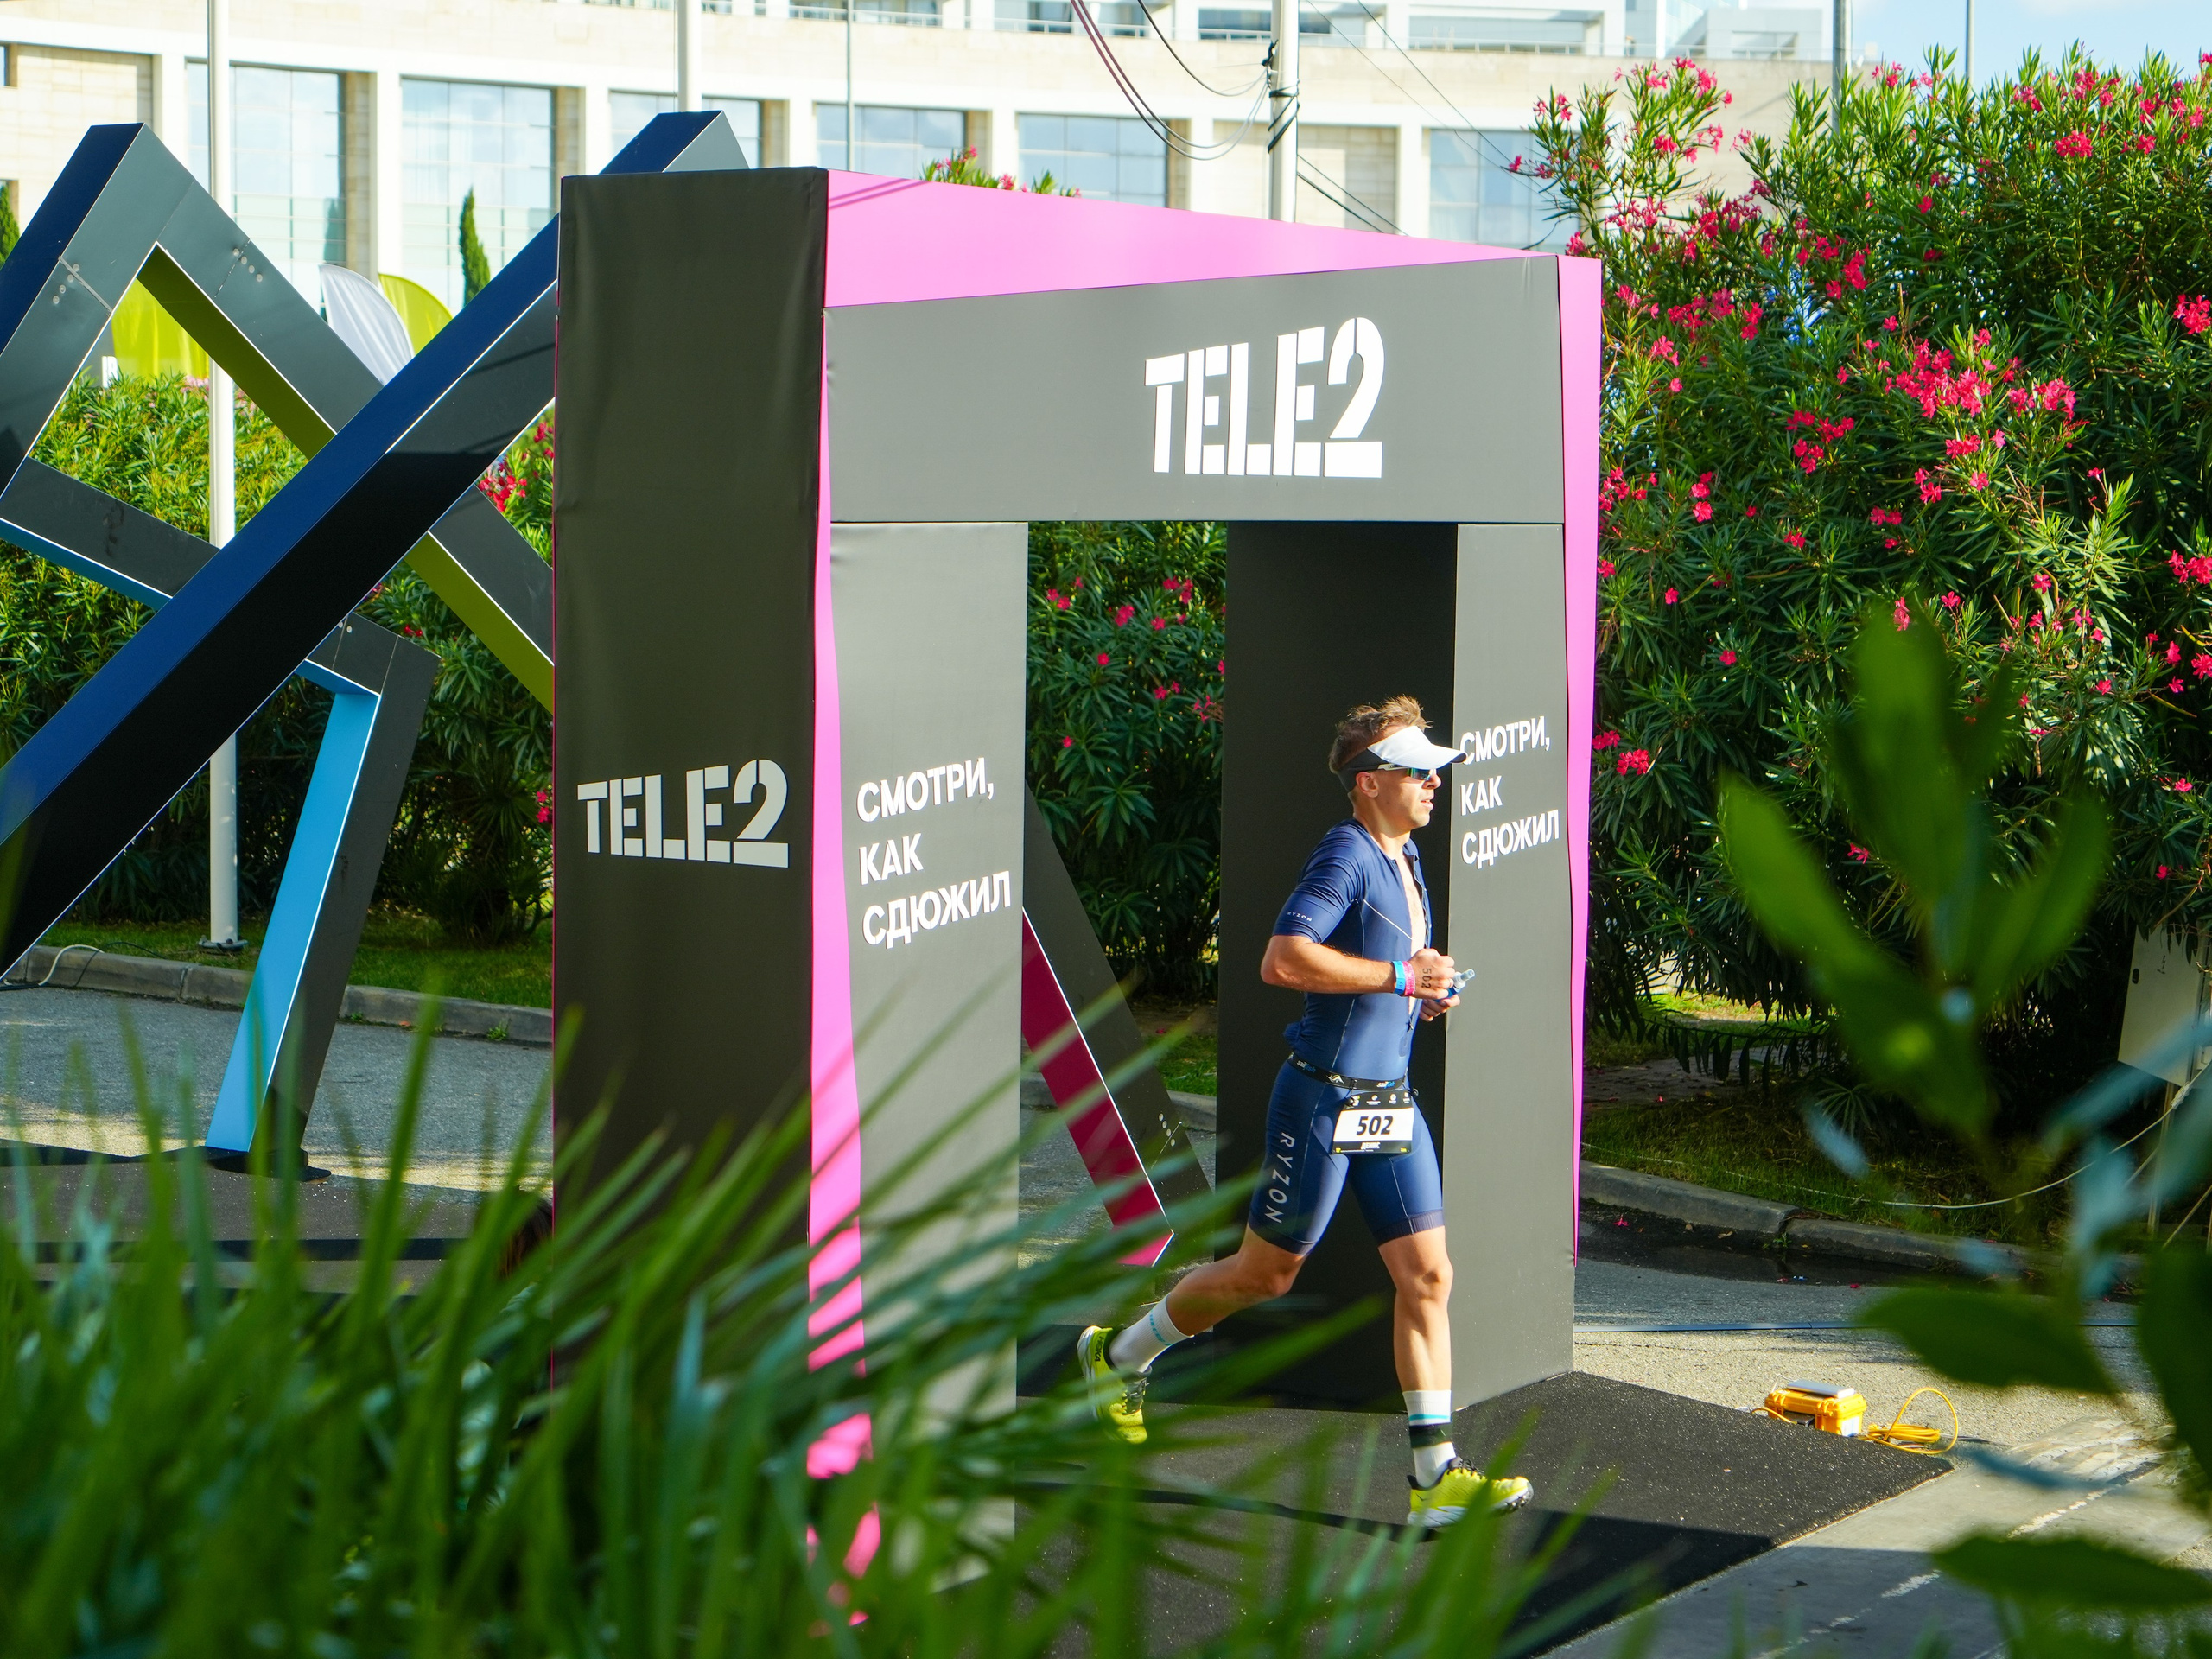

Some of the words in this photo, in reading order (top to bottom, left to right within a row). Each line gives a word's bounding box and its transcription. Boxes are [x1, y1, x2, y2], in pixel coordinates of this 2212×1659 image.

[1144, 316, 1384, 478] TELE2
[1459, 715, 1550, 766] СМОТРИ,
[577, 759, 789, 868] TELE2
[856, 757, 994, 822] СМОТРИ,
[1460, 775, 1503, 816] КАК
[859, 833, 924, 885] КАК
[1461, 809, 1560, 869] СДЮЖИЛ
[862, 870, 1011, 950] СДЮЖИЛ
[1287, 911, 1313, 922] RYZON
[1421, 968, 1432, 989] 502
[1356, 1116, 1394, 1136] 502
[1264, 1132, 1295, 1224] RYZON
[1094, 1336, 1105, 1362] HOKA
